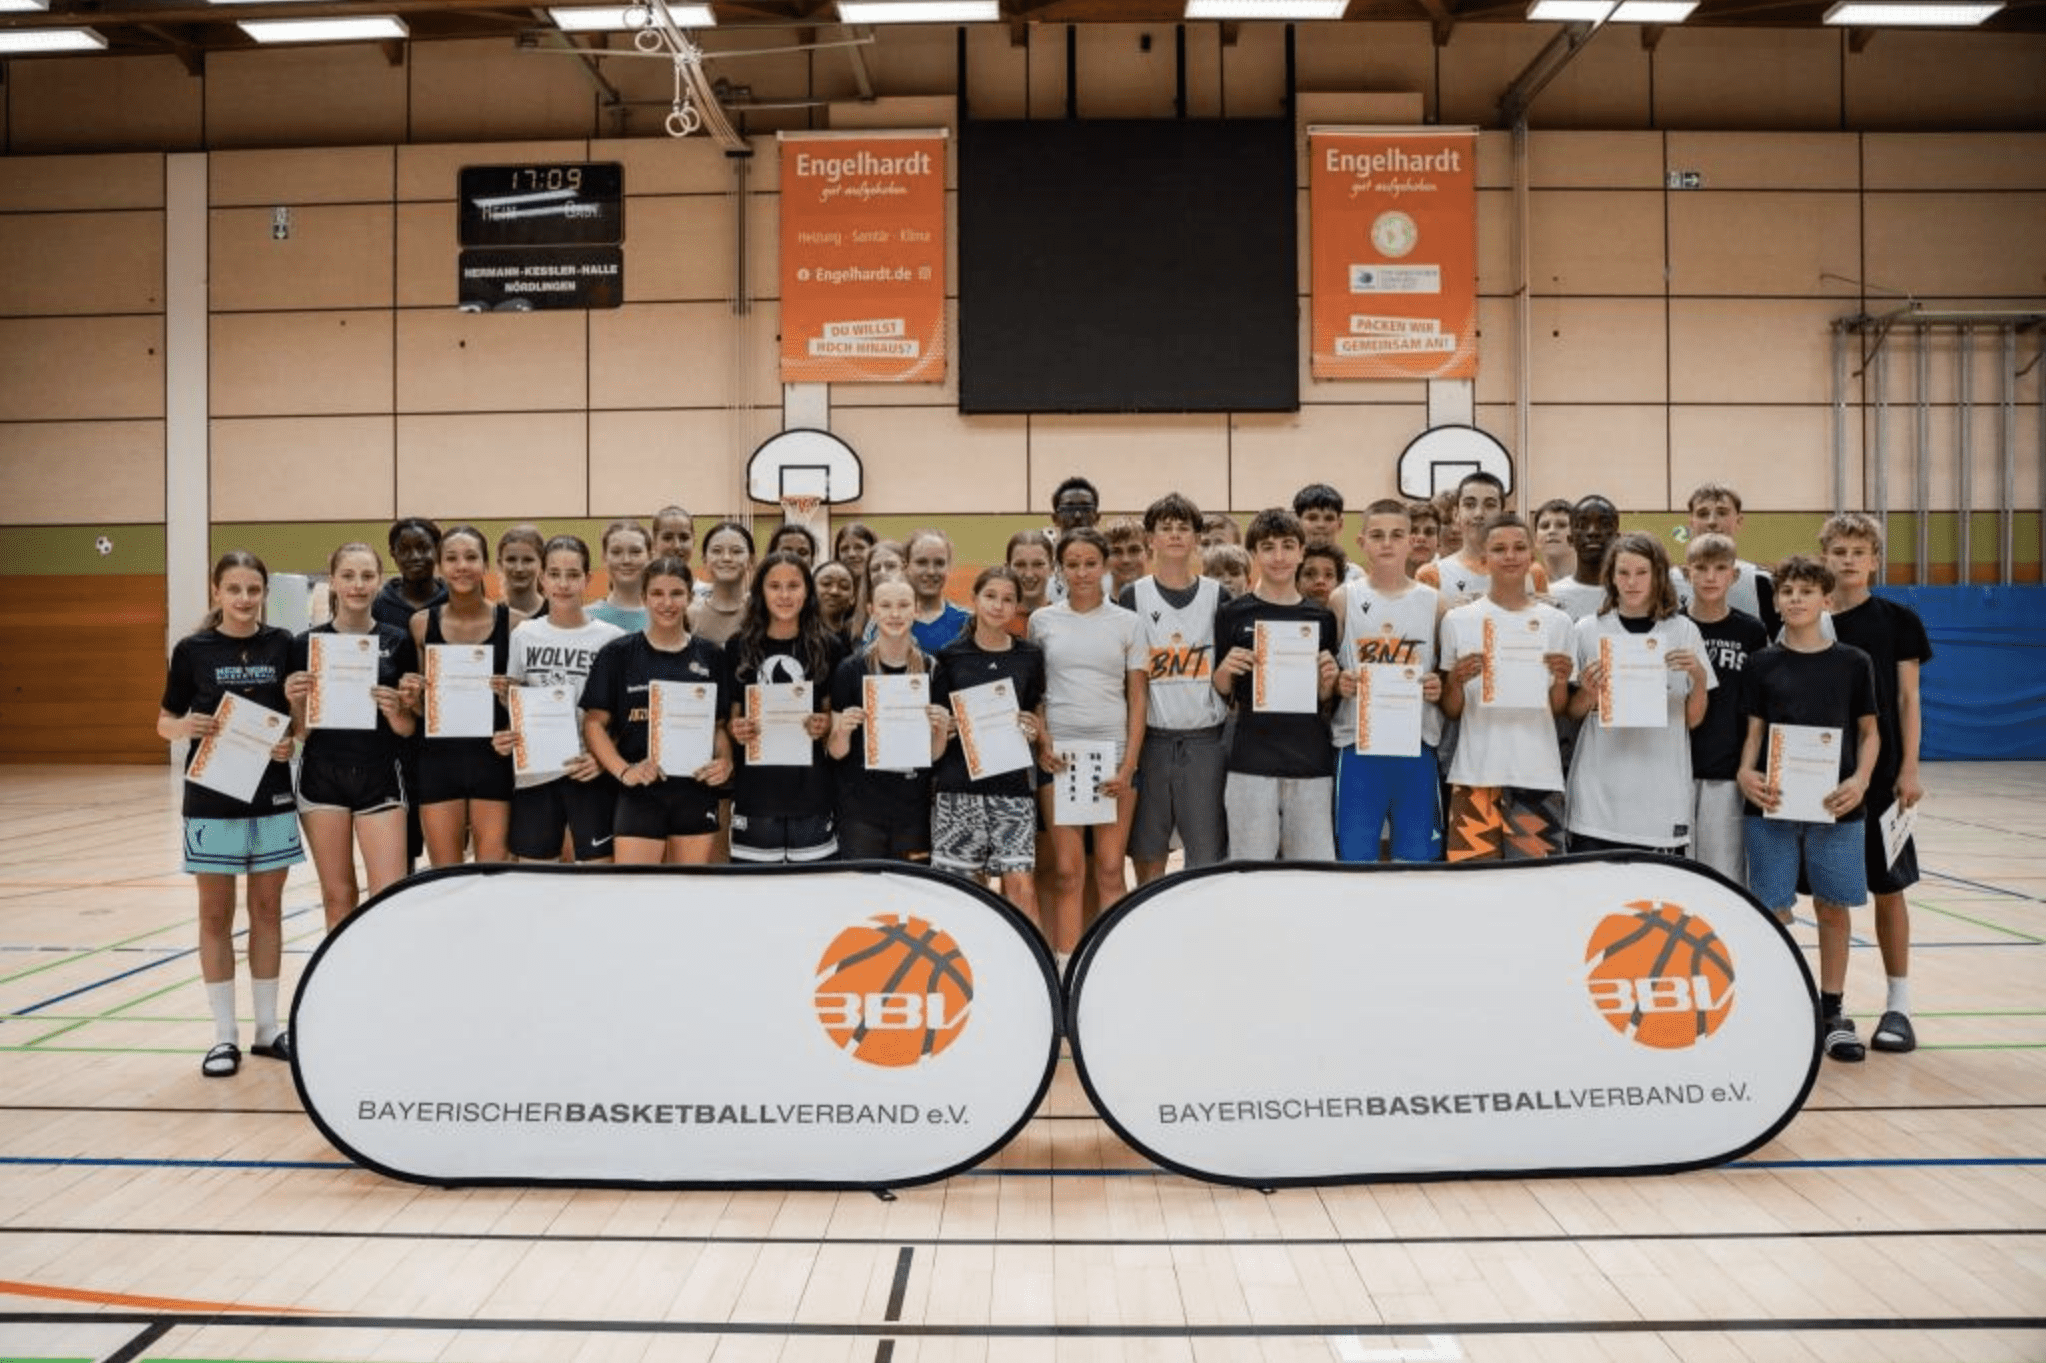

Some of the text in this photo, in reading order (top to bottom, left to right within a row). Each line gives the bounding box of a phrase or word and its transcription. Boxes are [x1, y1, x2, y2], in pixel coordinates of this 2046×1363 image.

[796, 151, 931, 183] Engelhardt
[1326, 148, 1461, 178] Engelhardt
[512, 168, 582, 190] 17:09
[816, 265, 912, 284] Engelhardt.de
[504, 280, 577, 293] NÖRDLINGEN
[1356, 318, 1435, 333] PACKEN WIR
[1342, 338, 1424, 352] GEMEINSAM
[526, 646, 600, 669] WOLVES
[1359, 632, 1427, 665] BNT
[1150, 643, 1214, 679] BNT
[358, 1101, 969, 1125] BAYERISCHERBASKETBALLVERBAND e.V.
[1159, 1083, 1751, 1124] BAYERISCHERBASKETBALLVERBAND e.V.
